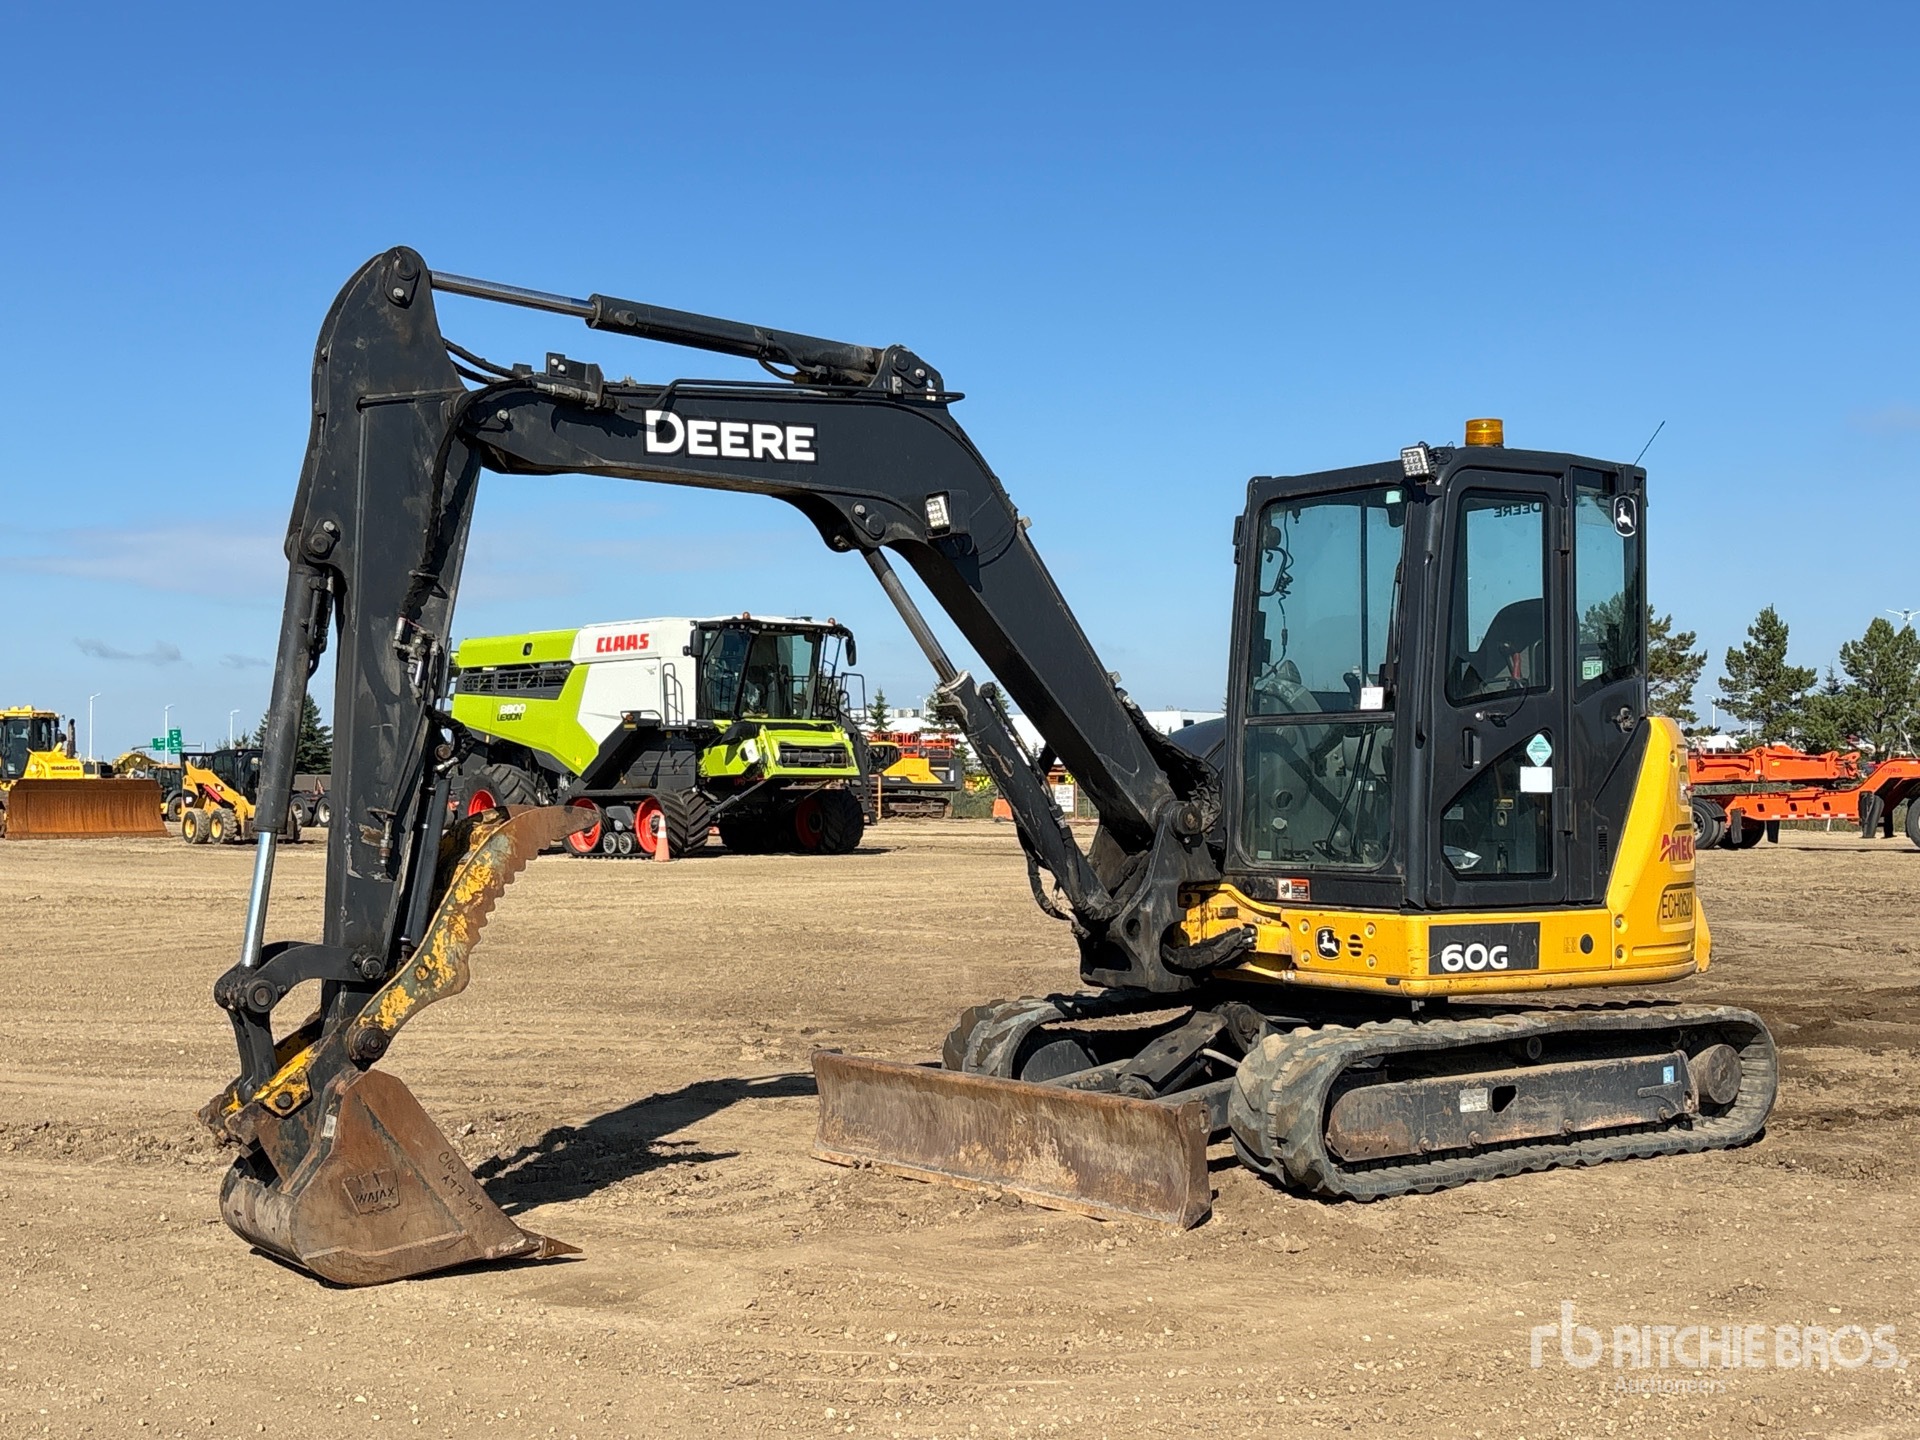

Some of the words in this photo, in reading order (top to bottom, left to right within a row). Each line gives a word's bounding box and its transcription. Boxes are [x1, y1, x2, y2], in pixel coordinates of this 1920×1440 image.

[645, 409, 816, 462] DEERE
[596, 633, 649, 653] CLAAS
[497, 712, 523, 722] LEXION
[1441, 943, 1508, 972] 60G
